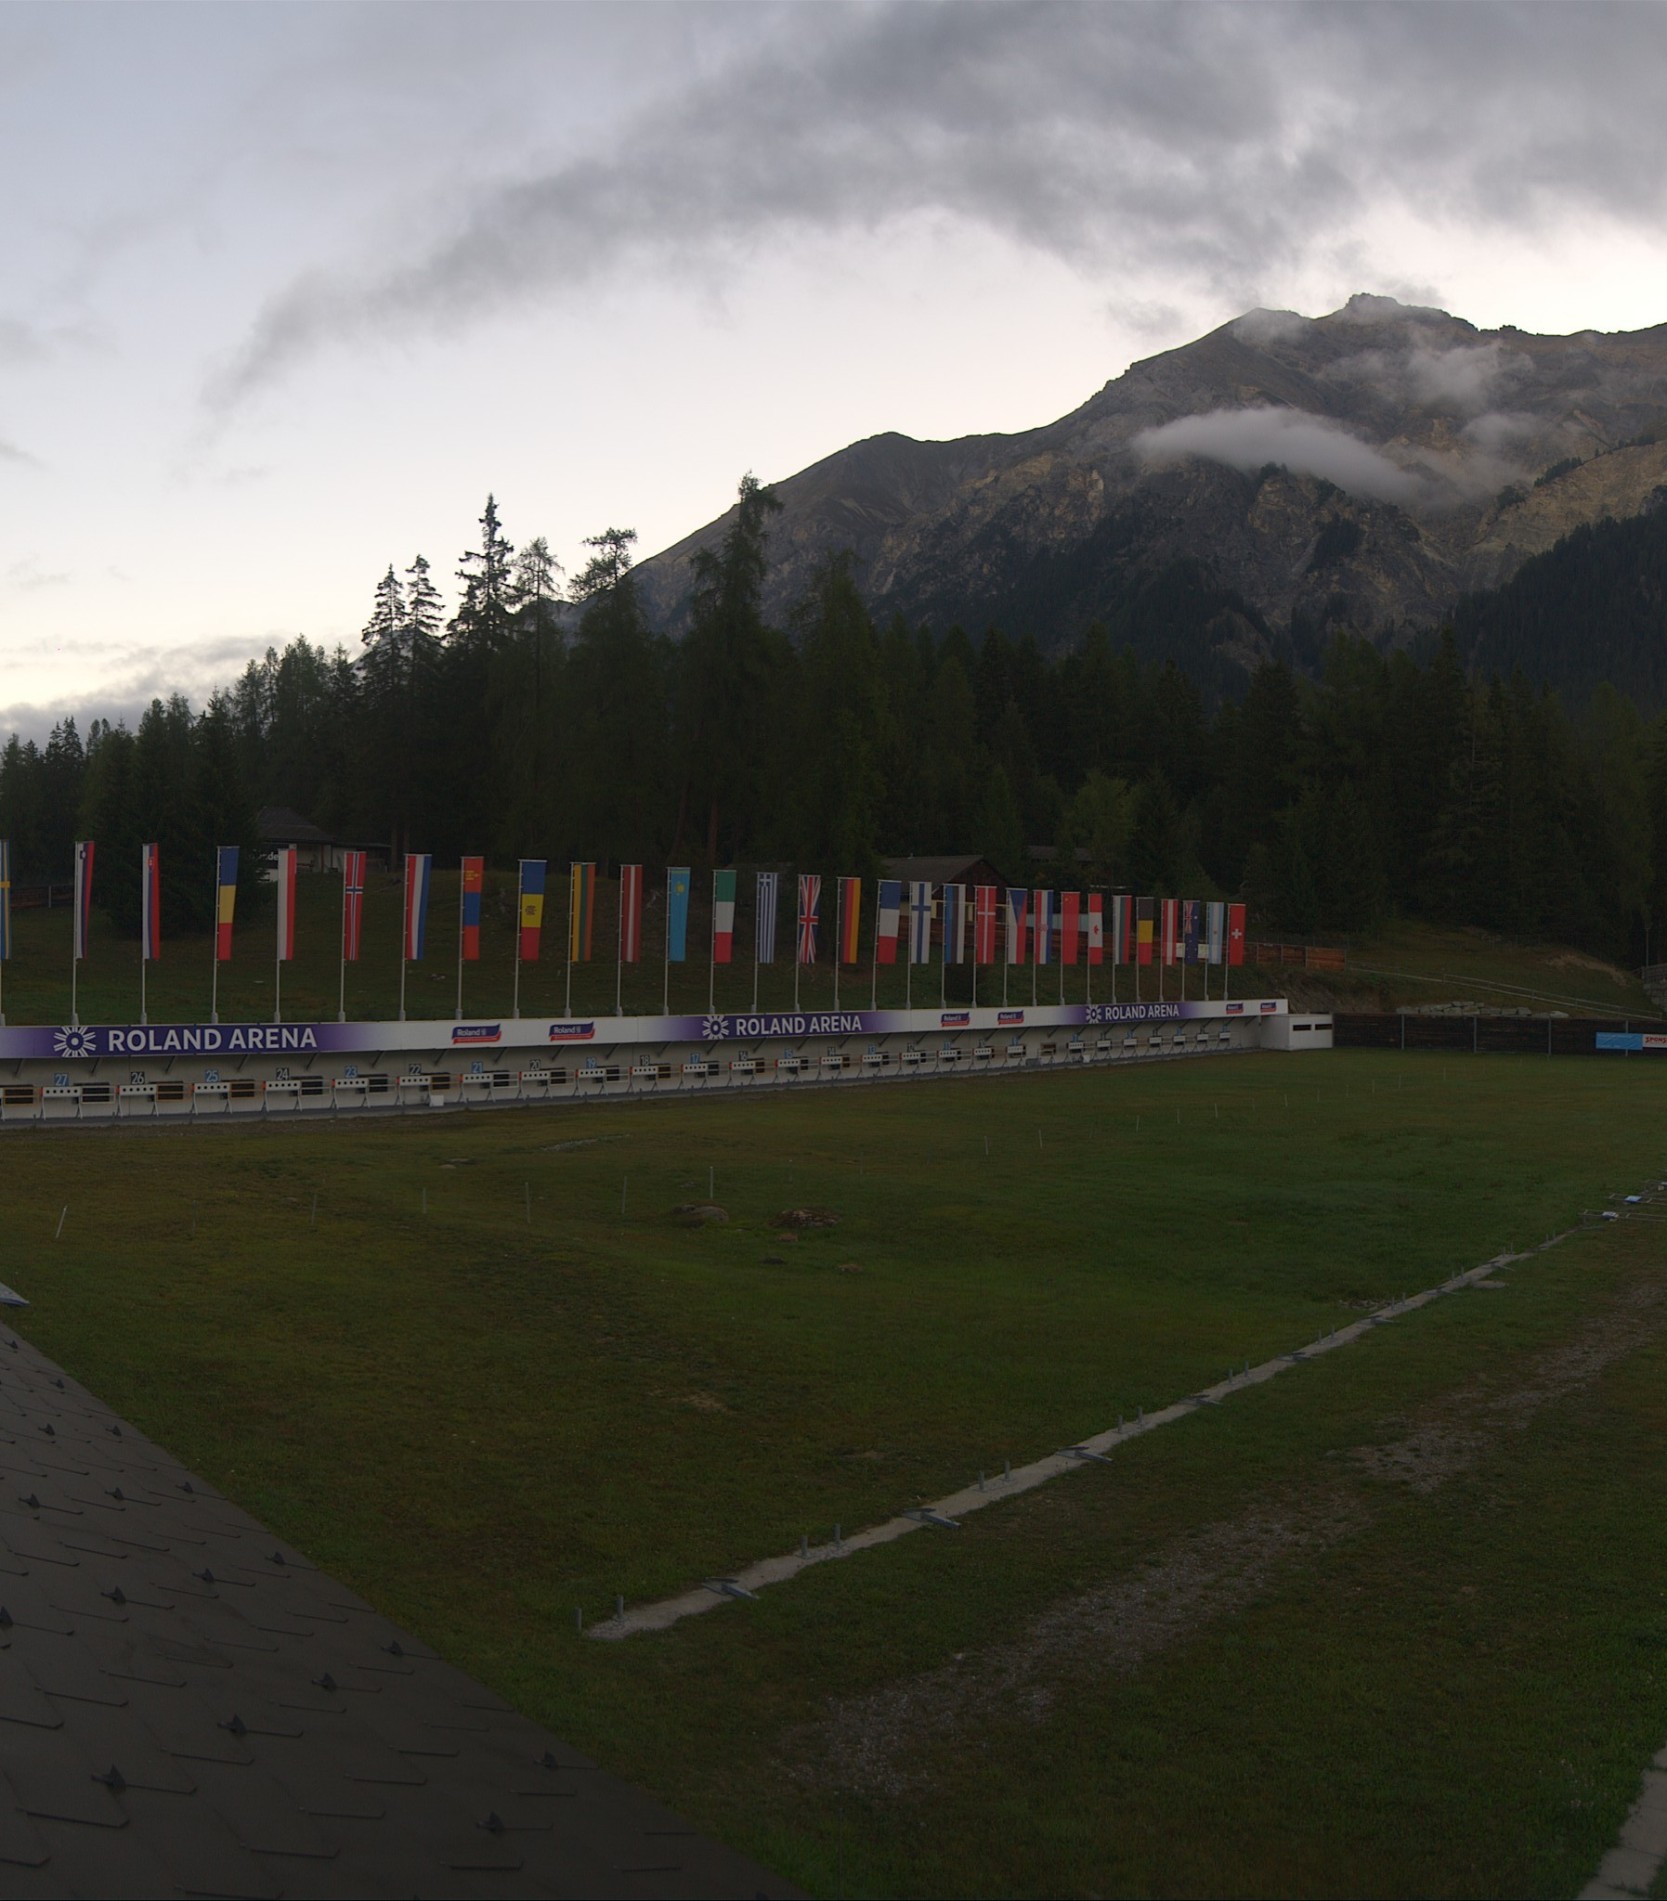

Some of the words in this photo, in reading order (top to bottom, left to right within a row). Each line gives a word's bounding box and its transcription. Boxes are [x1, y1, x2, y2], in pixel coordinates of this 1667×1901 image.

[1105, 1005, 1146, 1020] ROLAND
[1148, 1004, 1179, 1018] ARENA
[553, 1026, 575, 1034] Roland
[736, 1018, 805, 1035] ROLAND
[810, 1016, 862, 1033] ARENA
[457, 1028, 480, 1037] Roland
[108, 1028, 222, 1052] ROLAND
[229, 1027, 318, 1050] ARENA
[276, 1069, 289, 1080] 24
[346, 1066, 357, 1077] 23
[409, 1064, 421, 1075] 22
[55, 1074, 68, 1086] 27
[131, 1072, 145, 1084] 26
[206, 1070, 218, 1082] 25
